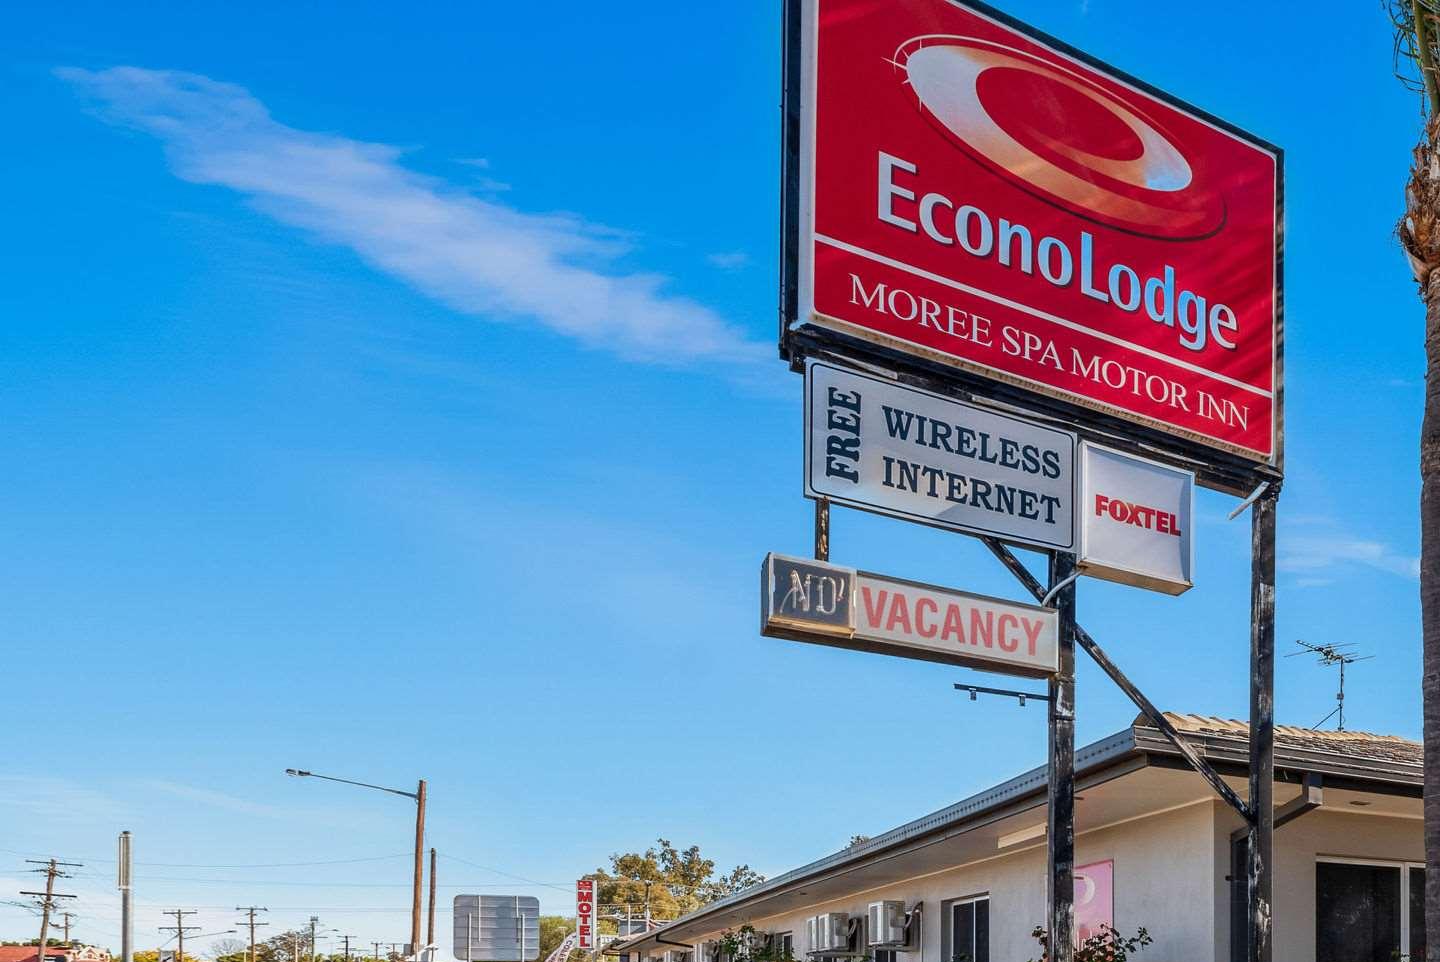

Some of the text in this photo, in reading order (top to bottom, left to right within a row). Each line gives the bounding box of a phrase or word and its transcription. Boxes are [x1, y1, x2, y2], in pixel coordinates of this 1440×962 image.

[848, 272, 1250, 433] MOREE SPA MOTOR INN
[825, 386, 862, 485] FREE
[881, 405, 1062, 480] WIRELESS
[881, 455, 1062, 525] INTERNET
[1094, 494, 1182, 537] FOXTEL
[860, 586, 1045, 657] VACANCY
[577, 892, 592, 947] MOTEL
